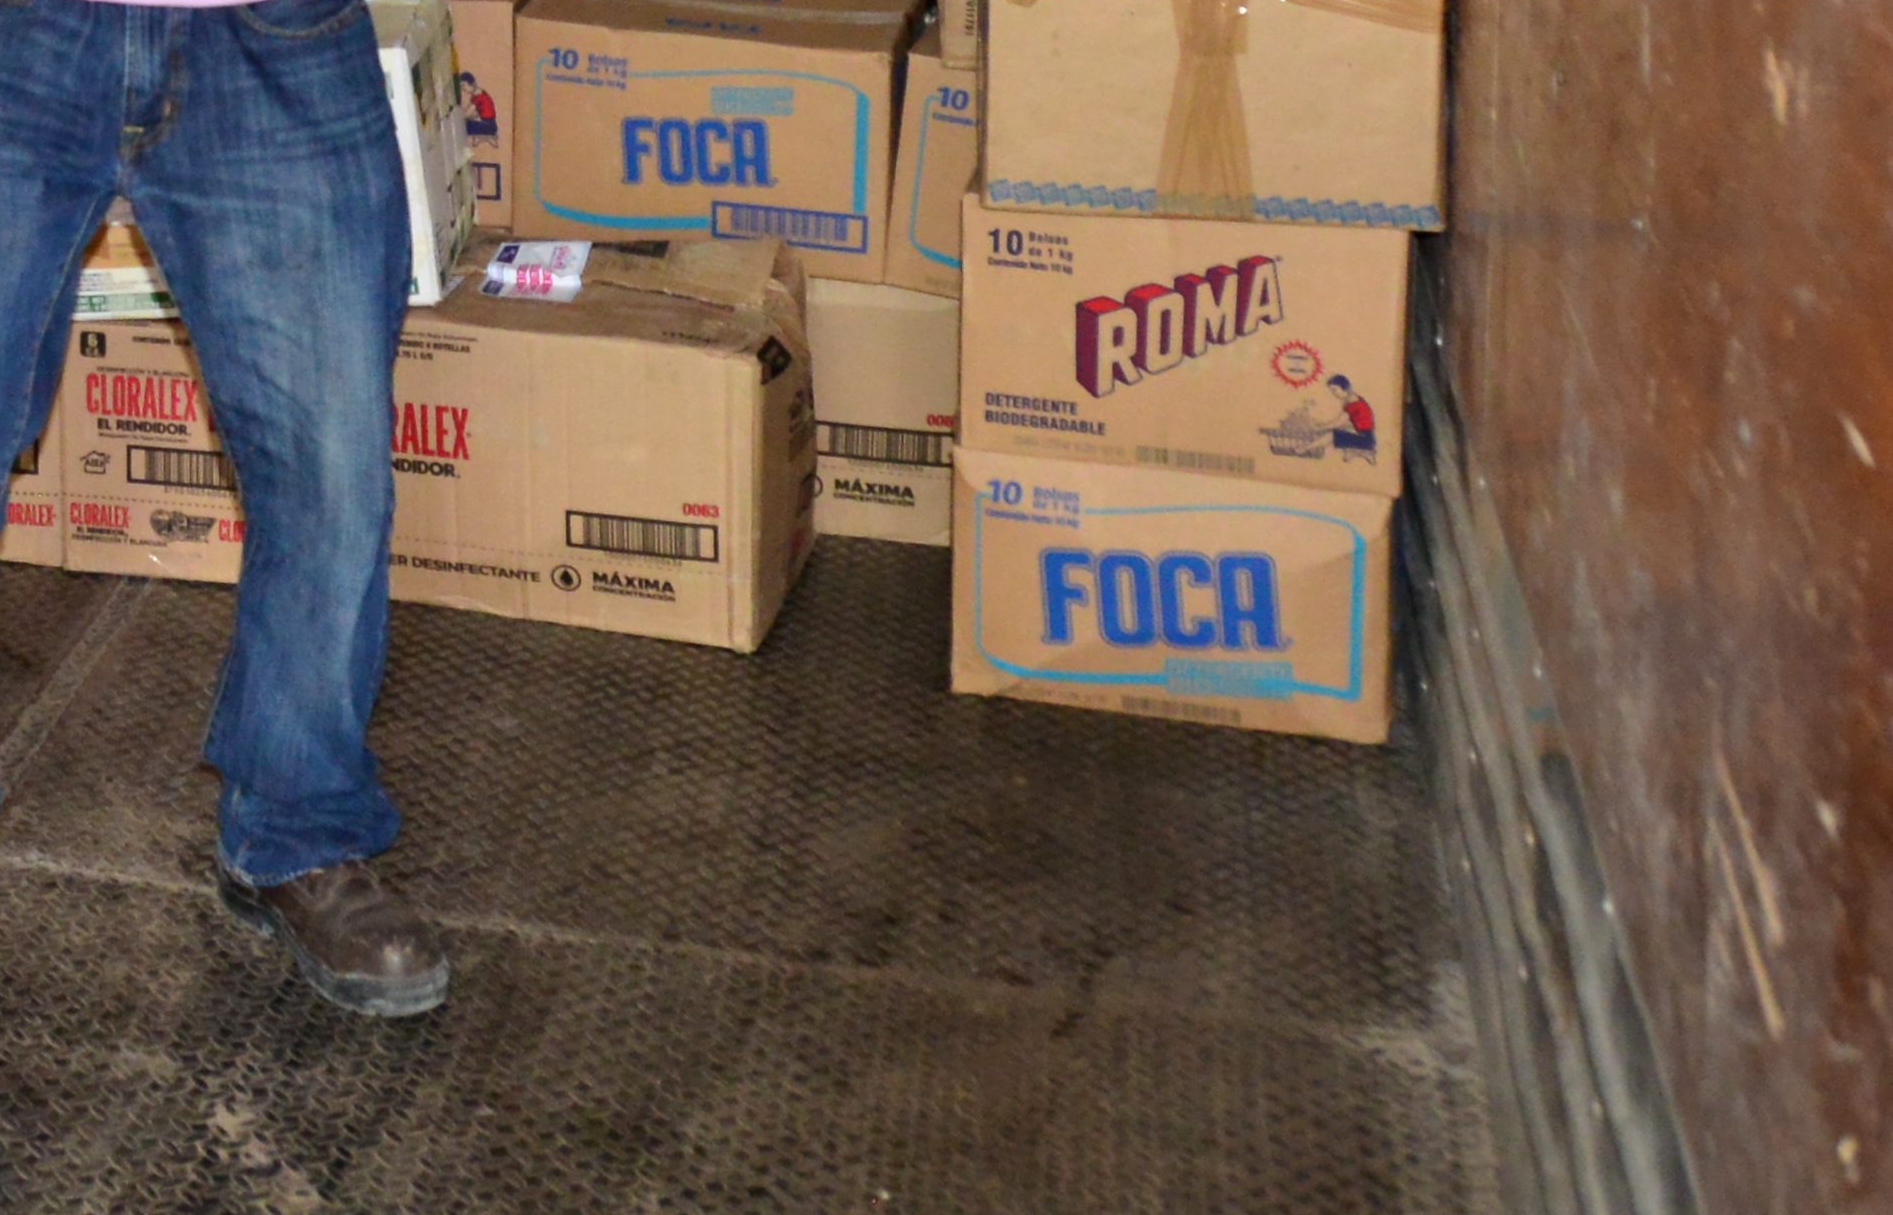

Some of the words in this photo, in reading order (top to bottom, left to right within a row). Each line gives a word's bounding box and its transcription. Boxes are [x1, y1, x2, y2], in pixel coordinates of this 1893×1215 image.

[548, 48, 580, 71] 10
[937, 86, 970, 111] 10
[621, 115, 774, 188] FOCA
[988, 228, 1024, 257] 10
[1028, 231, 1068, 246] Bolsas
[1075, 254, 1284, 399] ROMA
[85, 372, 199, 423] CLORALEX
[985, 391, 1078, 416] DETERGENTE
[97, 417, 111, 431] EL
[984, 409, 1107, 437] BIODEGRADABLE
[833, 478, 916, 500] MÁXIMA
[987, 479, 1023, 506] 10
[69, 501, 130, 529] CLORALEX
[411, 557, 542, 584] DESINFECTANTE
[592, 571, 675, 594] MÁXIMA
[1040, 546, 1286, 652] FOCA
